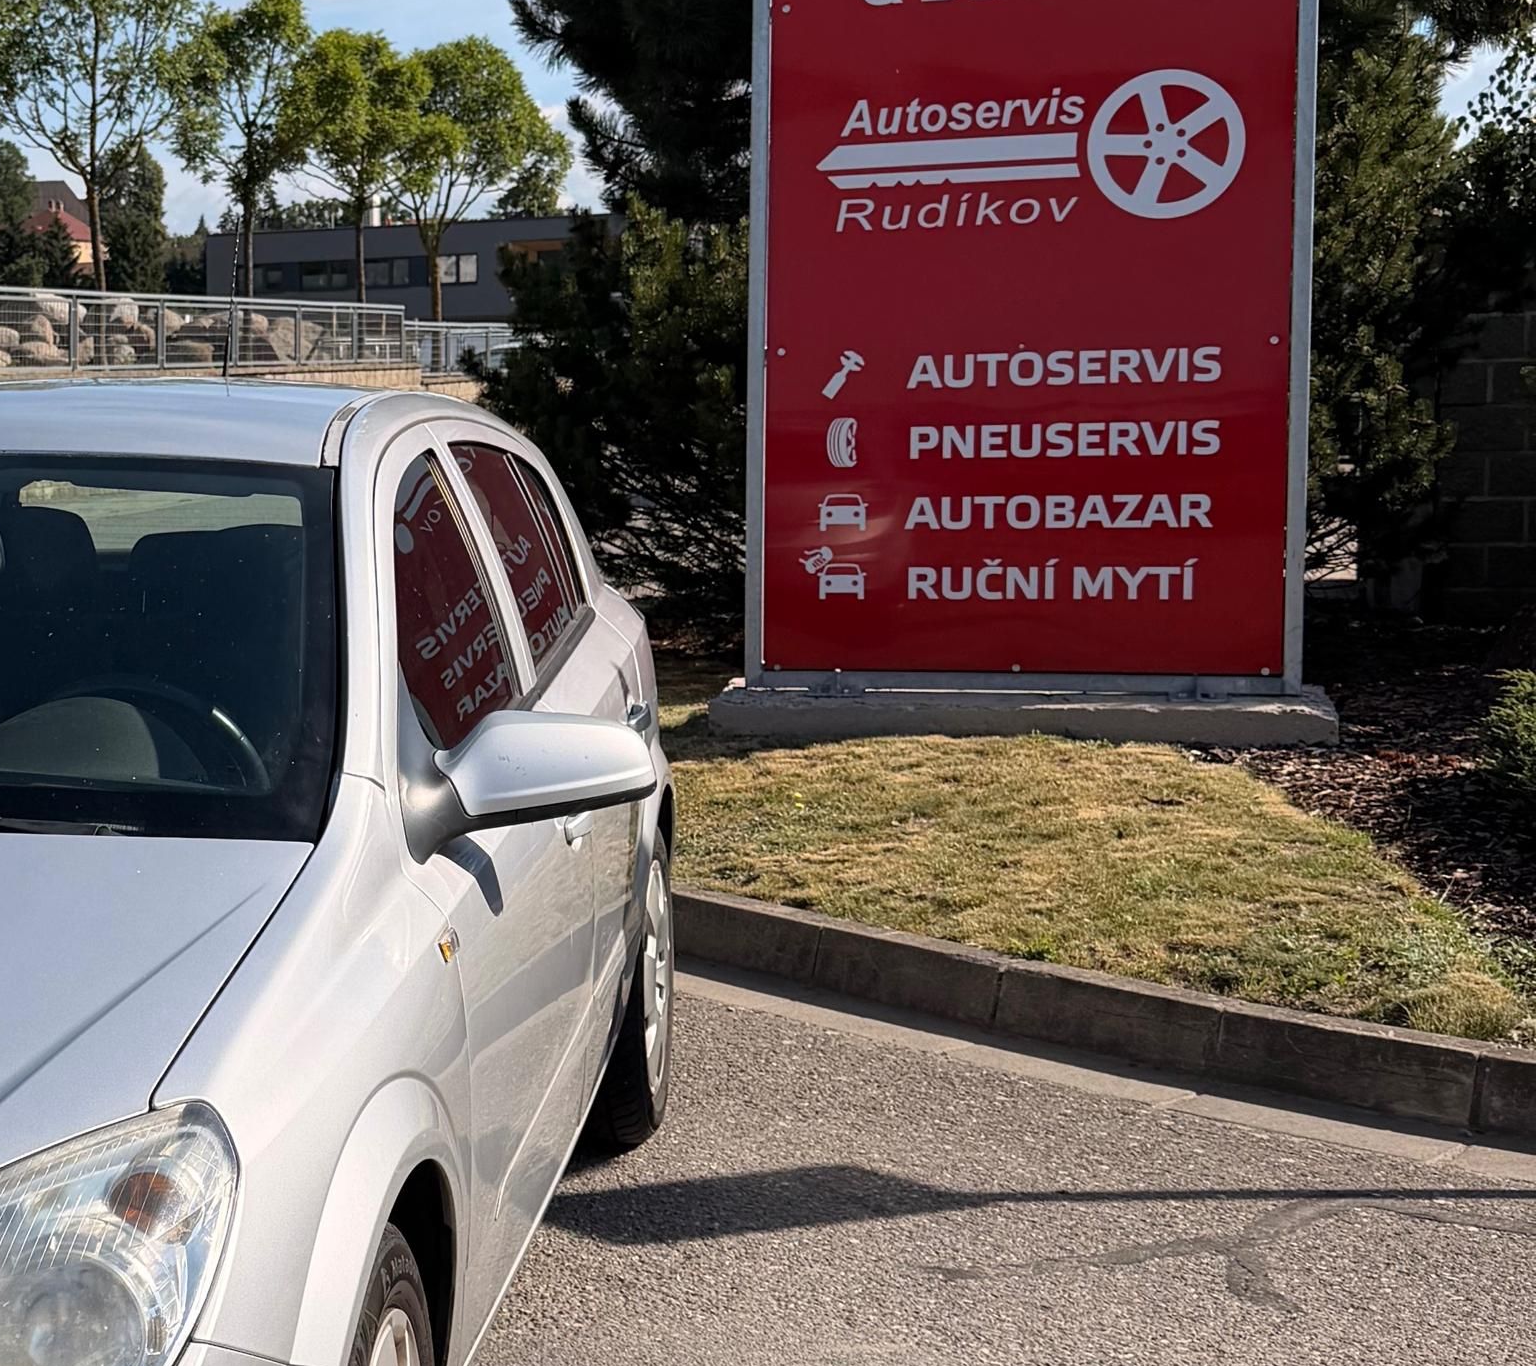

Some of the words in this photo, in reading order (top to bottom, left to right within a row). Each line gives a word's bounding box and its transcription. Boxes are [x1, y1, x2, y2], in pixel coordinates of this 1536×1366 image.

[840, 87, 1086, 138] Autoservis
[835, 191, 1079, 233] Rudíkov
[906, 346, 1222, 389] AUTOSERVIS
[909, 419, 1221, 460] PNEUSERVIS
[904, 493, 1213, 531] AUTOBAZAR
[907, 558, 1059, 601] RUČNÍ
[1072, 557, 1199, 601] MYTÍ
